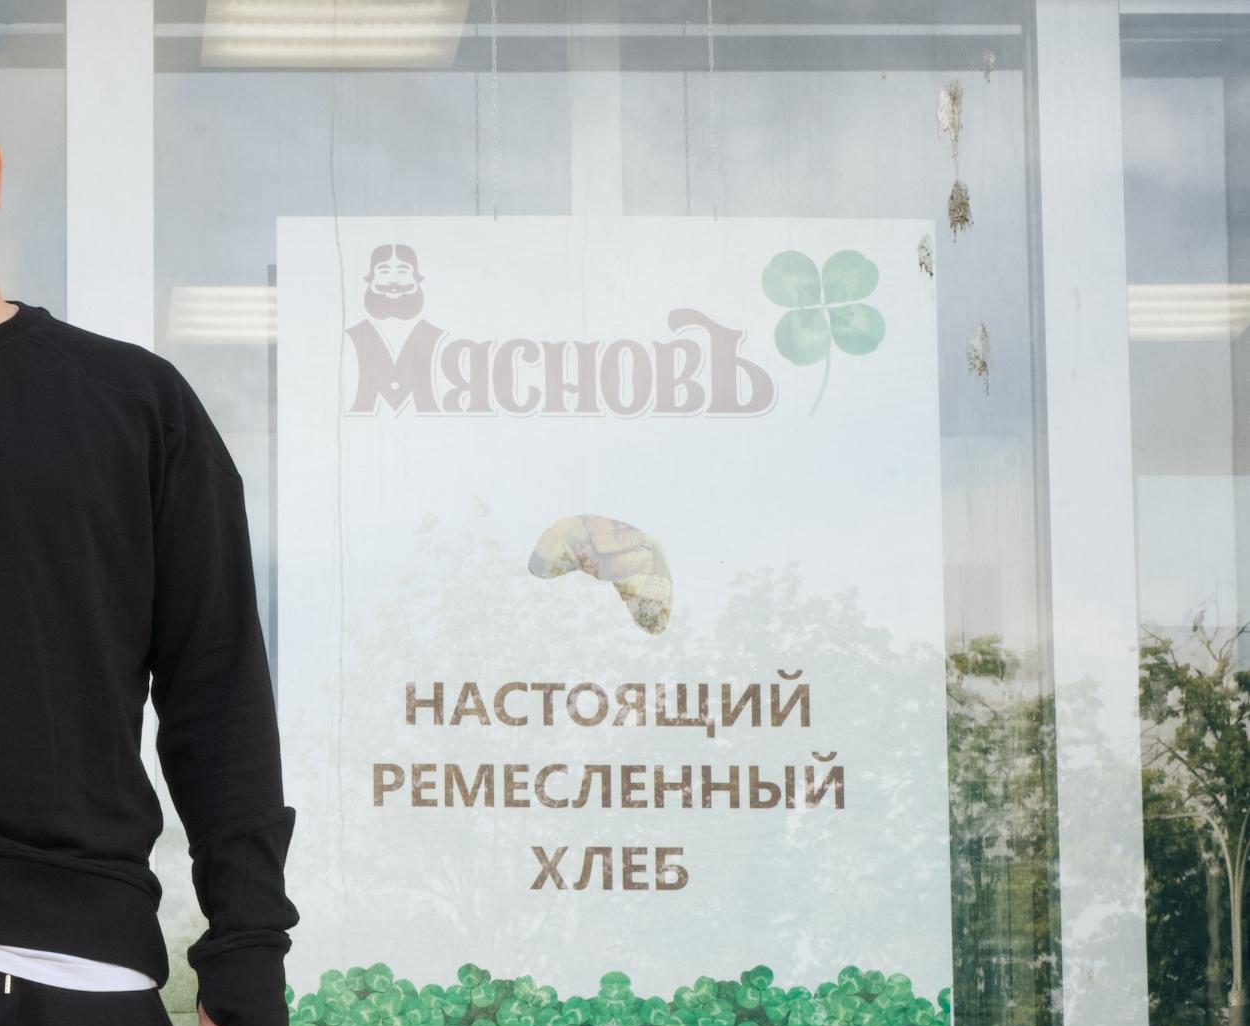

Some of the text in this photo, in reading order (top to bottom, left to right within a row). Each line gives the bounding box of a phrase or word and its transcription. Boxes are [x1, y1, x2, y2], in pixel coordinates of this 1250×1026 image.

[405, 669, 811, 739] НАСТОЯЩИЙ
[373, 751, 846, 810] РЕМЕСЛЕННЫЙ
[529, 846, 690, 891] ХЛЕБ
